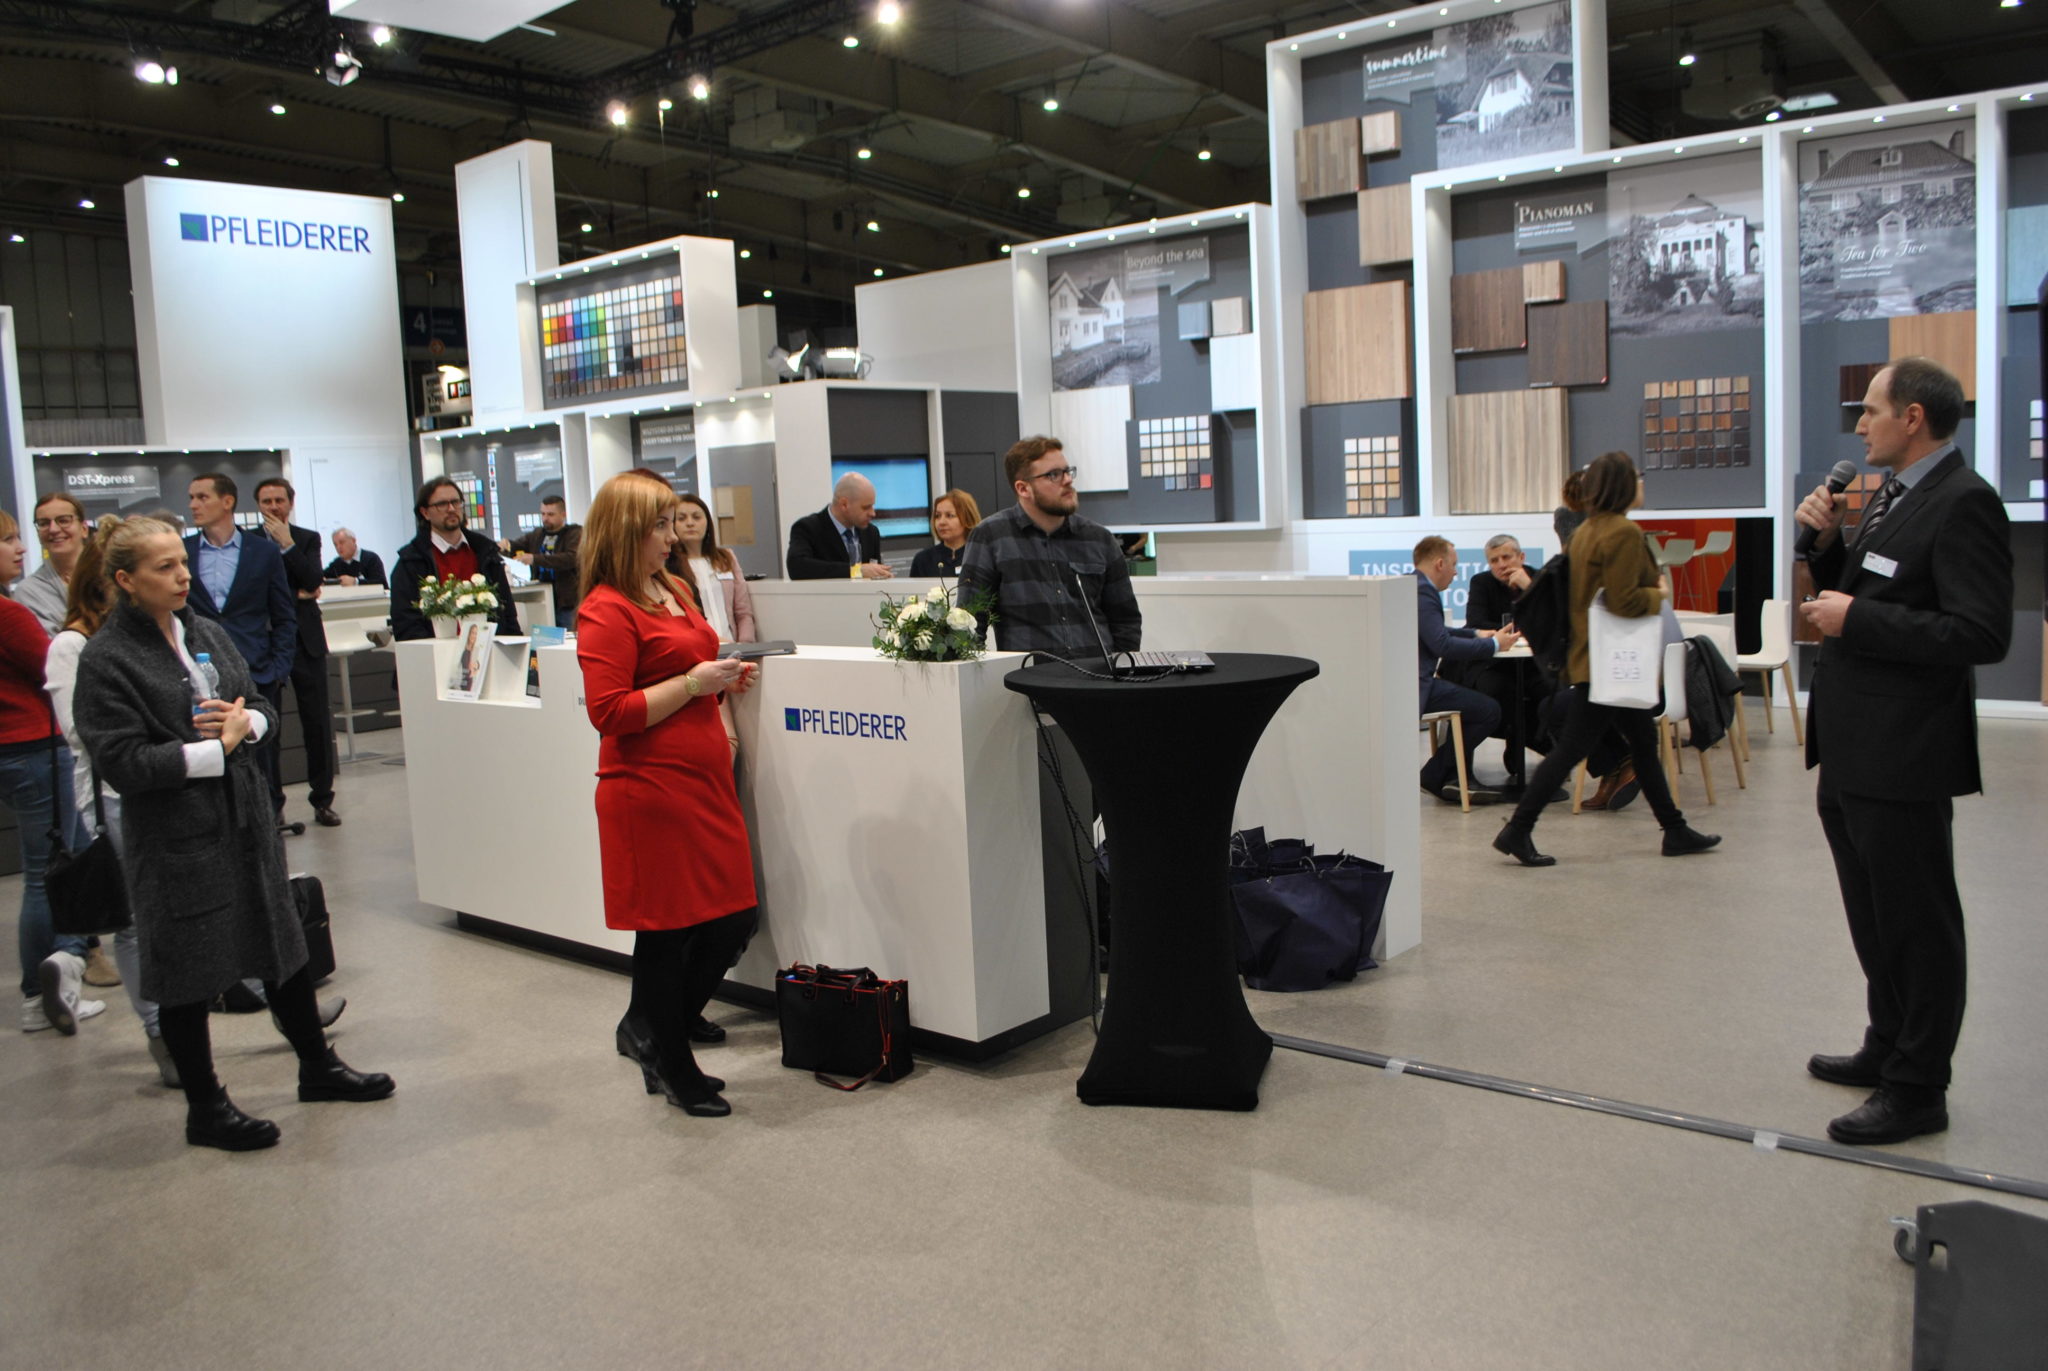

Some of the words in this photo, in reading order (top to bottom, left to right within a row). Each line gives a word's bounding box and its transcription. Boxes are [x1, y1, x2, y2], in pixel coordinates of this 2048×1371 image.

[211, 215, 371, 253] PFLEIDERER
[1127, 251, 1164, 270] Beyond
[1166, 249, 1184, 264] the
[1186, 248, 1204, 261] sea
[1840, 245, 1866, 262] Tea
[1864, 244, 1891, 264] for
[1895, 239, 1927, 257] Two
[802, 708, 907, 741] PFLEIDERER
